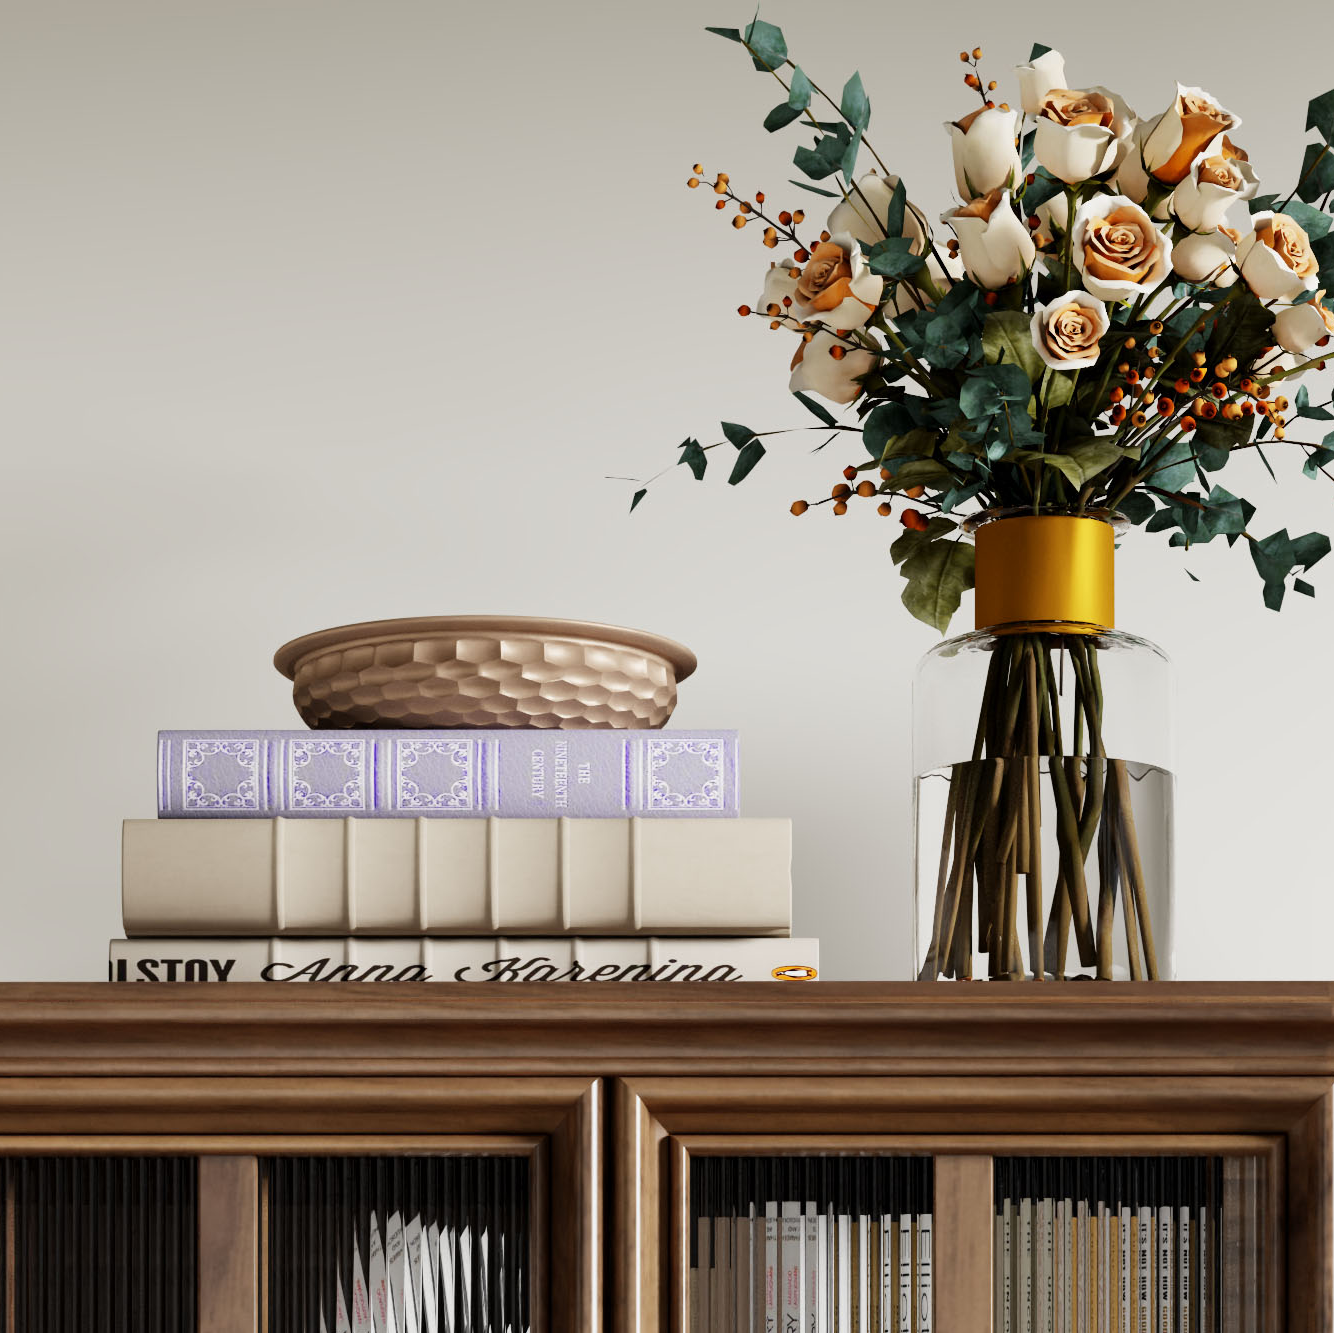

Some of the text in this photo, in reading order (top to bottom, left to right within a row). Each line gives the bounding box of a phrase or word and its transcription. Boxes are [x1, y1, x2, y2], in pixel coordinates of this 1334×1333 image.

[532, 750, 545, 800] CENTURY
[260, 957, 433, 983] Anna
[454, 957, 744, 982] Karenina
